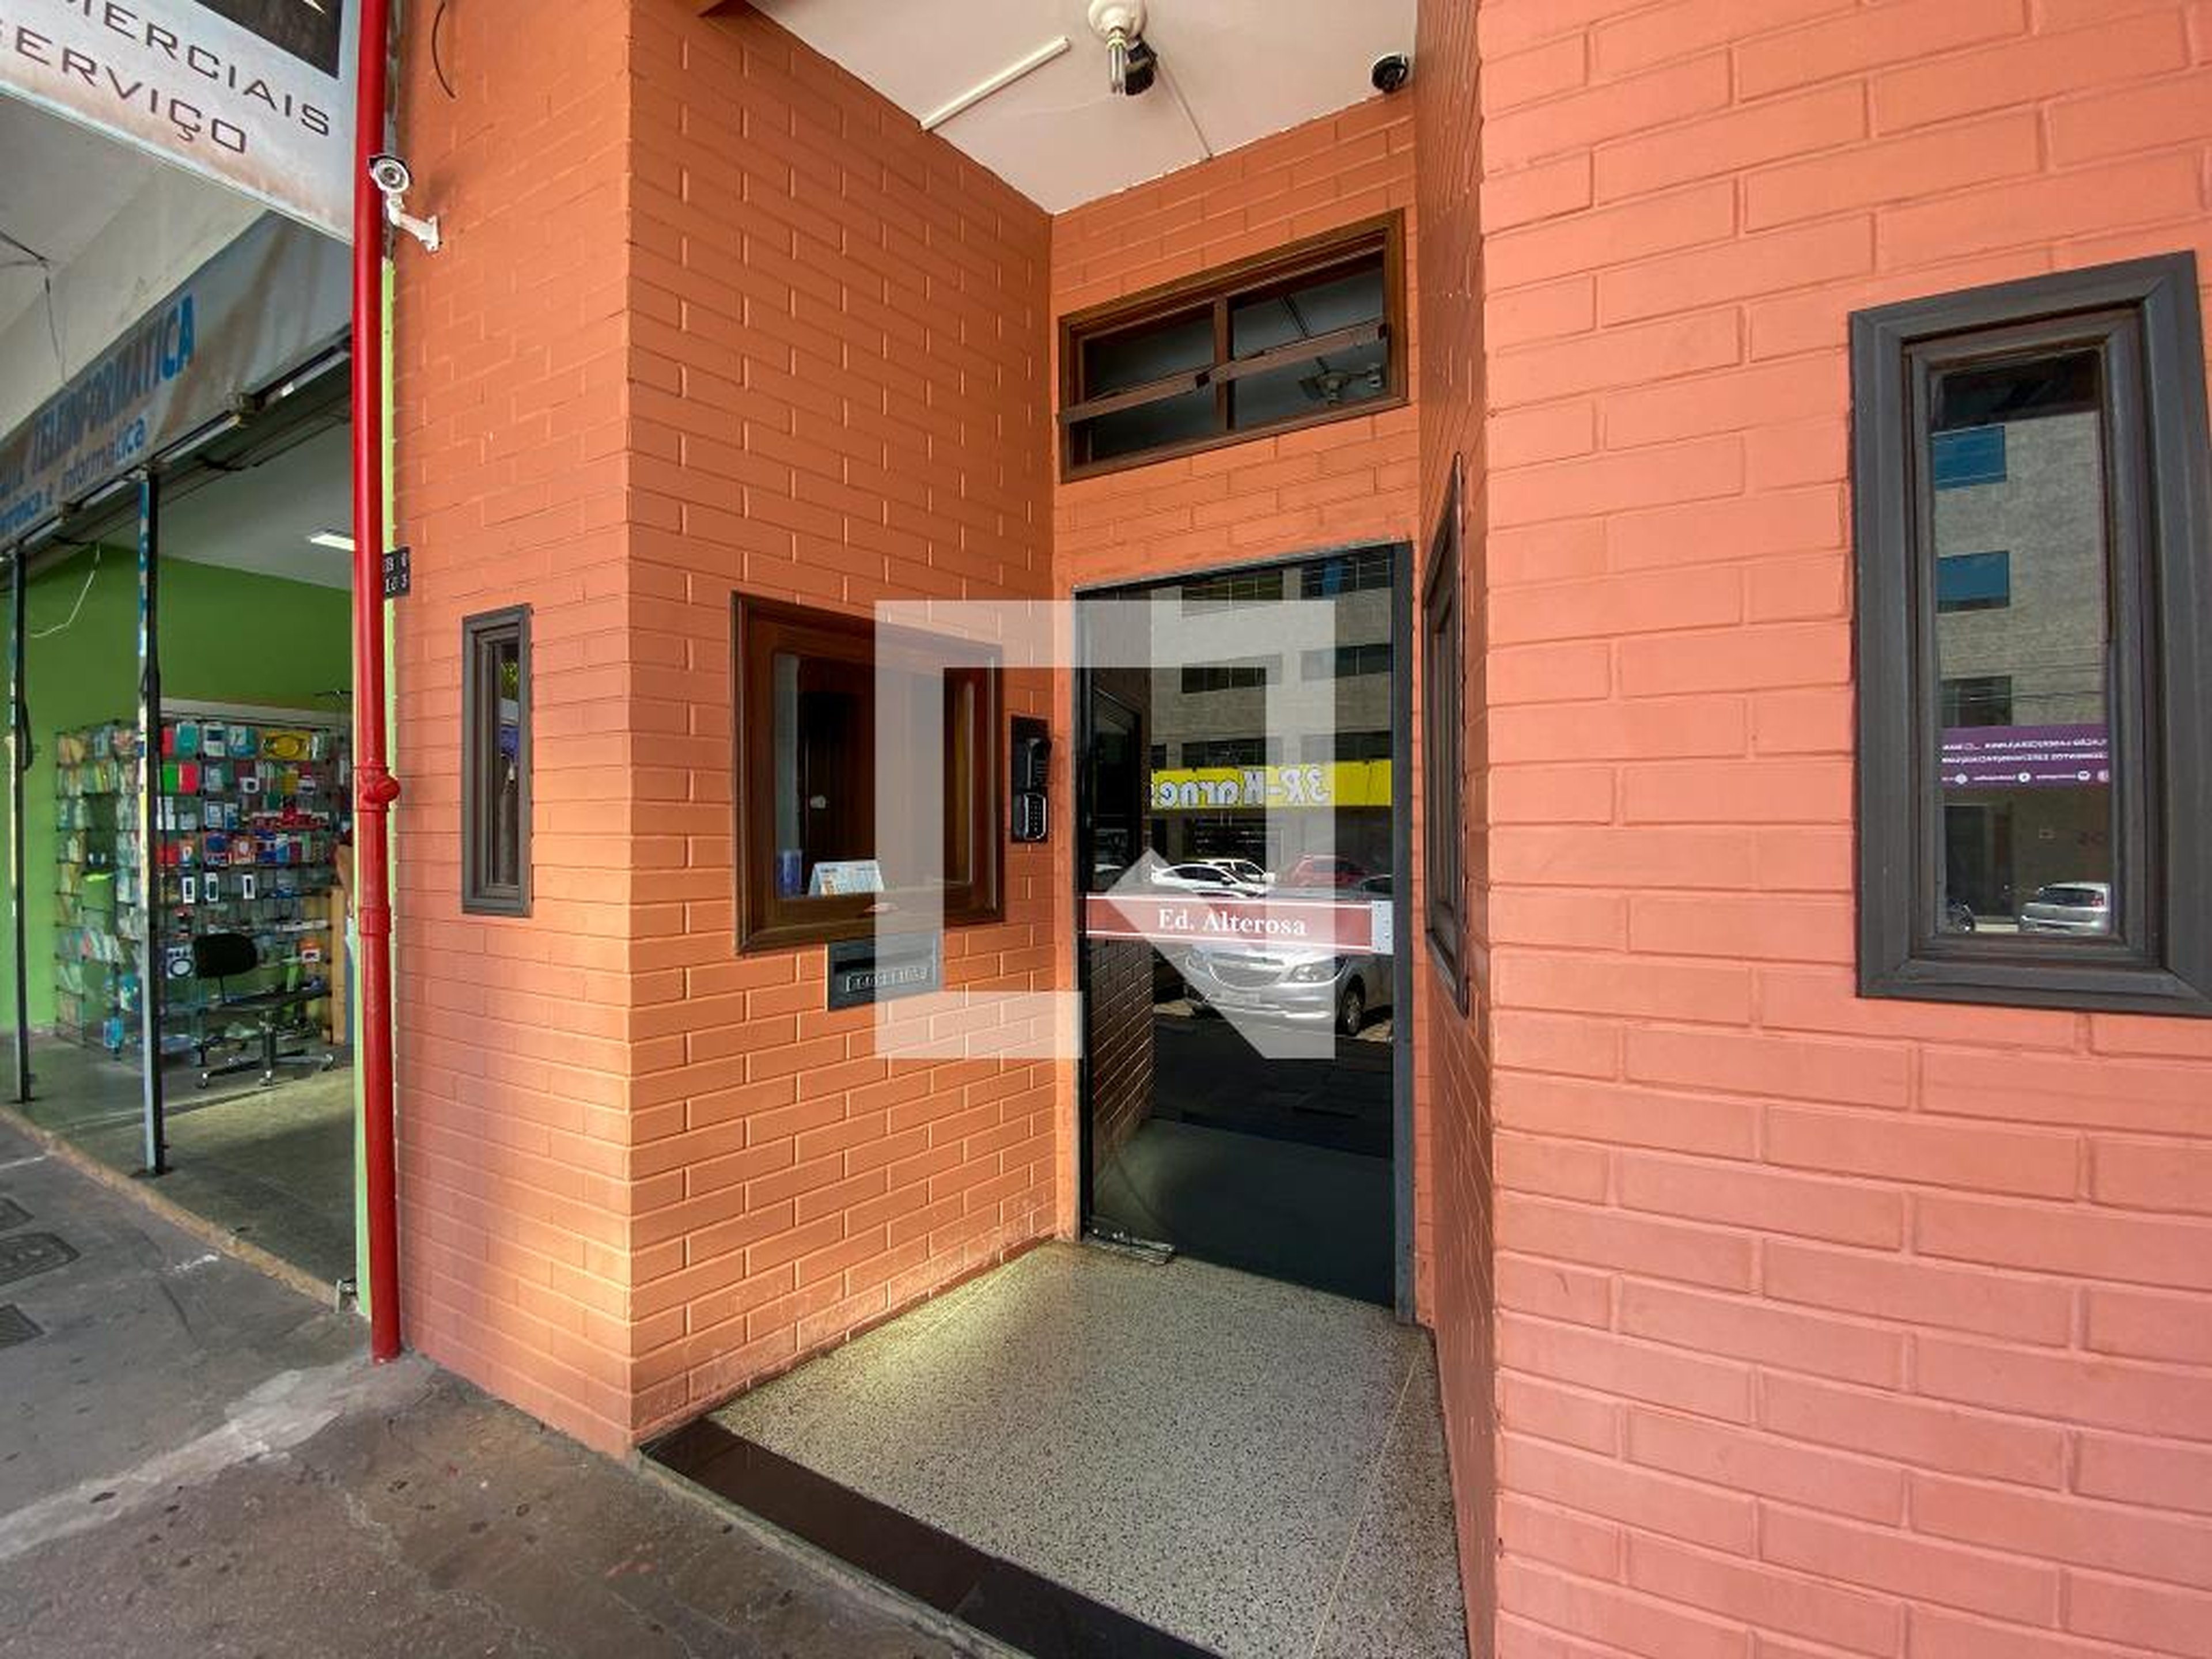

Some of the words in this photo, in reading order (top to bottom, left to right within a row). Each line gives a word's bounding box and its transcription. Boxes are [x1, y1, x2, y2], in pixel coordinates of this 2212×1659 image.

[0, 19, 246, 154] ERVIÇO
[1159, 908, 1194, 930] Ed.
[1202, 911, 1307, 935] Alterosa
